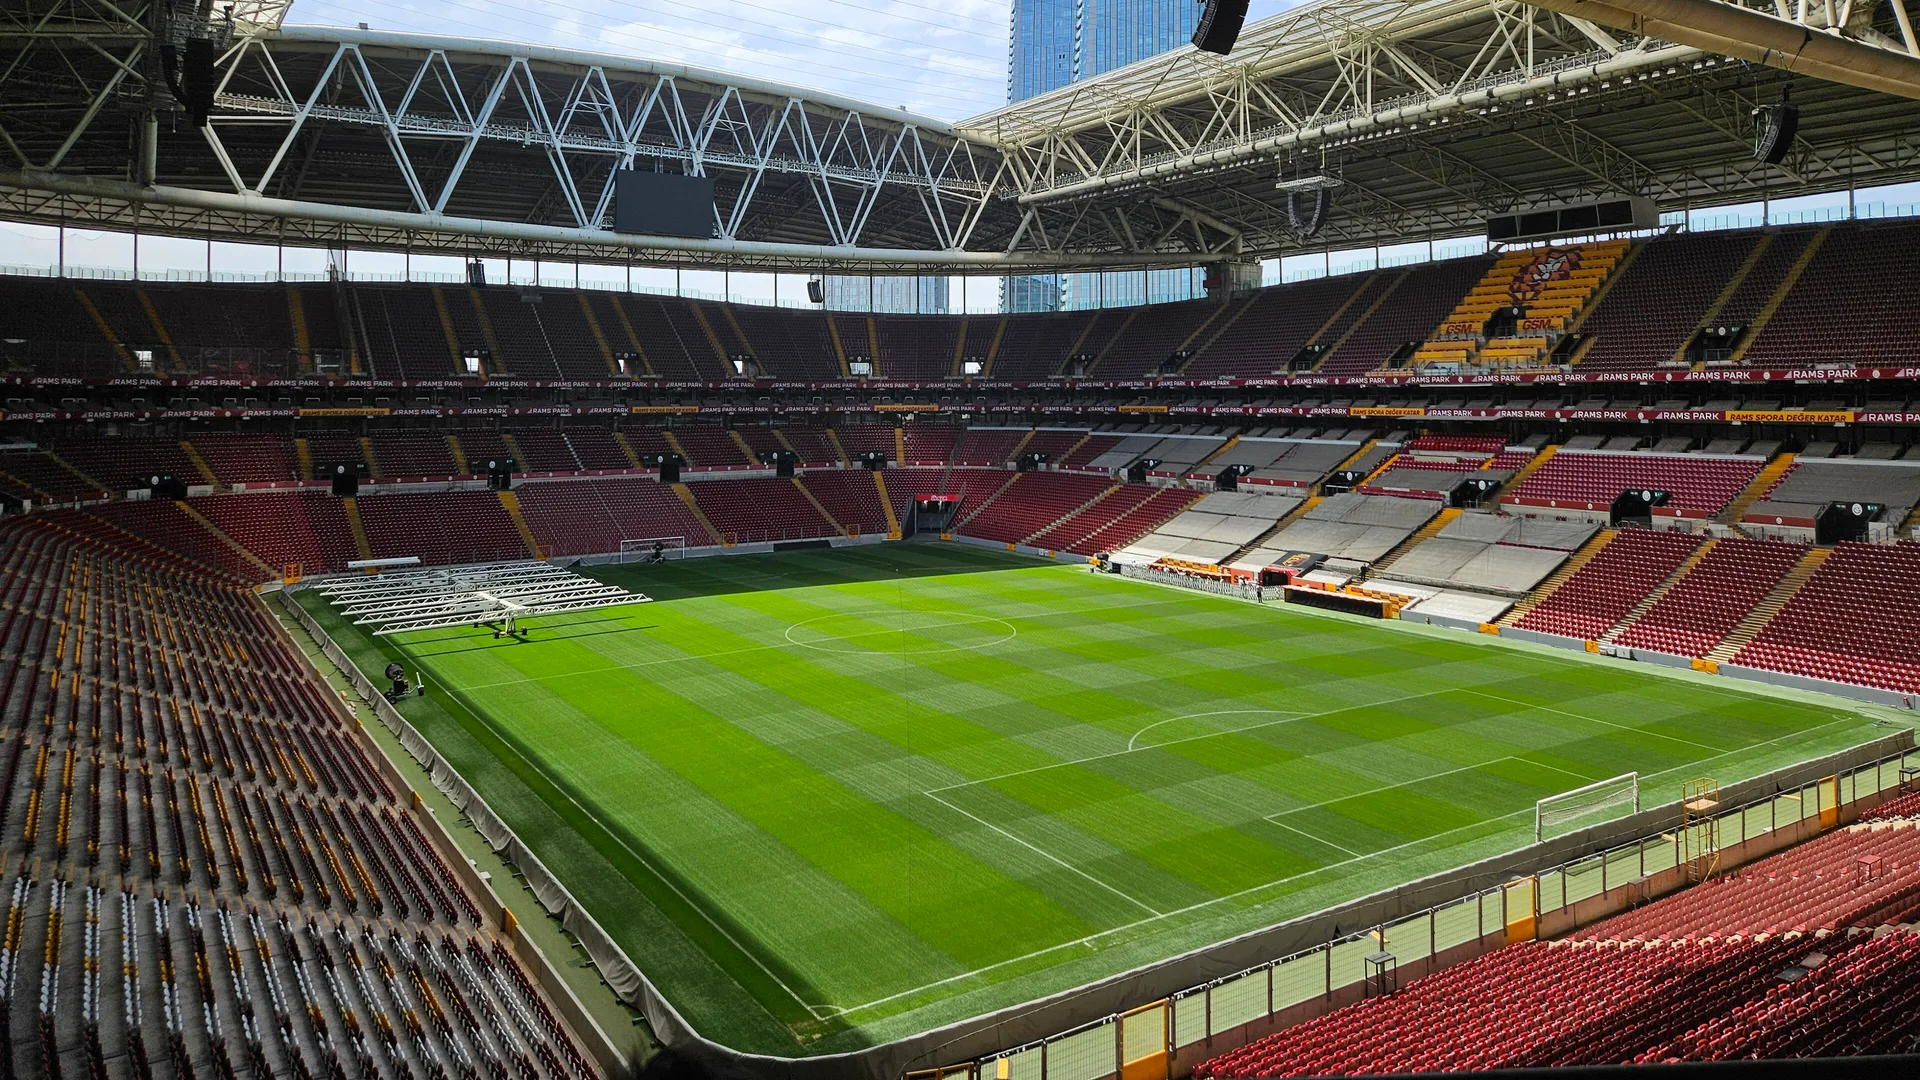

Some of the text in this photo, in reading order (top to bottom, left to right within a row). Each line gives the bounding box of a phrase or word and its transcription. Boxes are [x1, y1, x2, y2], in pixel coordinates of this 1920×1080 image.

[1446, 324, 1473, 334] GSM
[1523, 319, 1552, 331] GSM
[1692, 372, 1750, 380] RAMS PARK
[1794, 370, 1857, 378] RAMS PARK
[1664, 412, 1719, 420] RAMS PARK
[1730, 414, 1846, 422] RAMS SPORA DEĞER KATAR
[1868, 413, 1902, 422] RAMS
